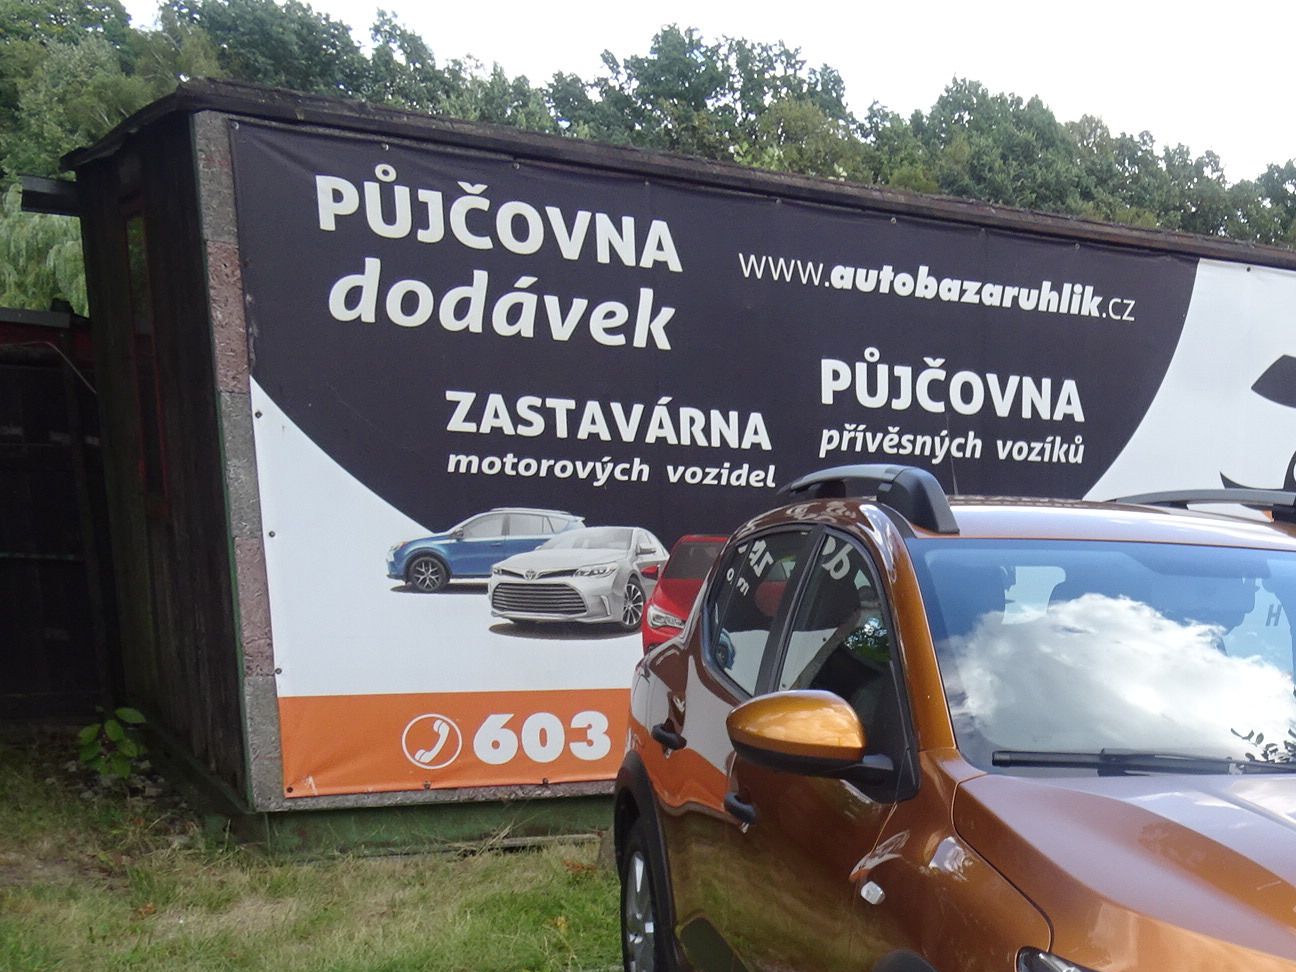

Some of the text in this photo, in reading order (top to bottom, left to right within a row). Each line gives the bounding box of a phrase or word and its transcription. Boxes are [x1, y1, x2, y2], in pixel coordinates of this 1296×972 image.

[315, 163, 683, 273] PŮJČOVNA
[328, 257, 676, 351] dodávek
[738, 252, 1136, 322] www.autobazaruhlik.cz
[820, 346, 1085, 423] PŮJČOVNA
[445, 390, 773, 451] ZASTAVÁRNA
[818, 423, 1085, 465] přívěsných vozíků
[447, 452, 776, 488] motorových vozidel
[472, 710, 612, 765] 603
